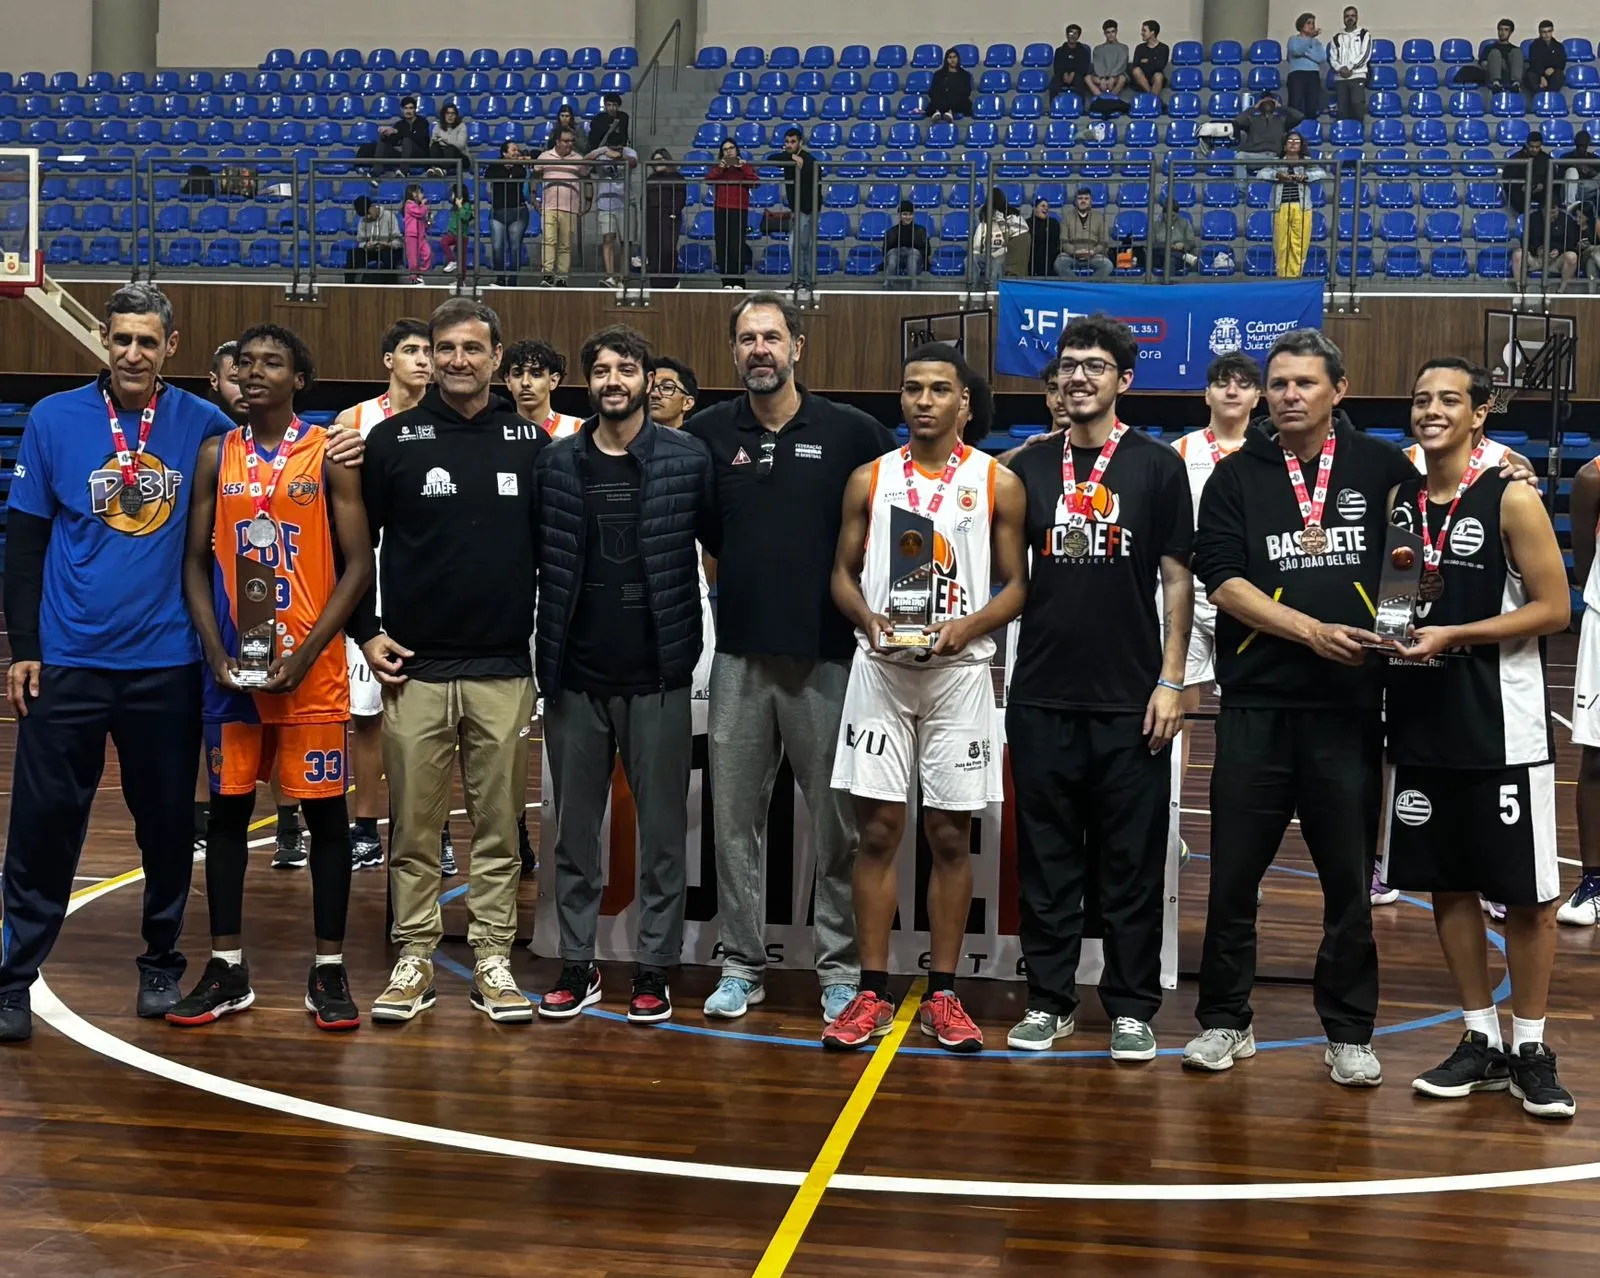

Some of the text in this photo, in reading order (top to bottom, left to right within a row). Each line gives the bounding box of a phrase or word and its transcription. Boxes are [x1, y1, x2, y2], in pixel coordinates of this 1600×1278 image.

[1018, 336, 1028, 347] A
[1033, 338, 1050, 350] TV
[1244, 341, 1264, 350] Juiz
[88, 468, 184, 514] PBF
[420, 480, 458, 496] JOTAEFE
[1040, 522, 1133, 557] JOEFE
[1265, 526, 1367, 561] BASUETE
[1326, 553, 1346, 566] DEL
[304, 748, 342, 784] 33
[1500, 784, 1521, 825] 5
